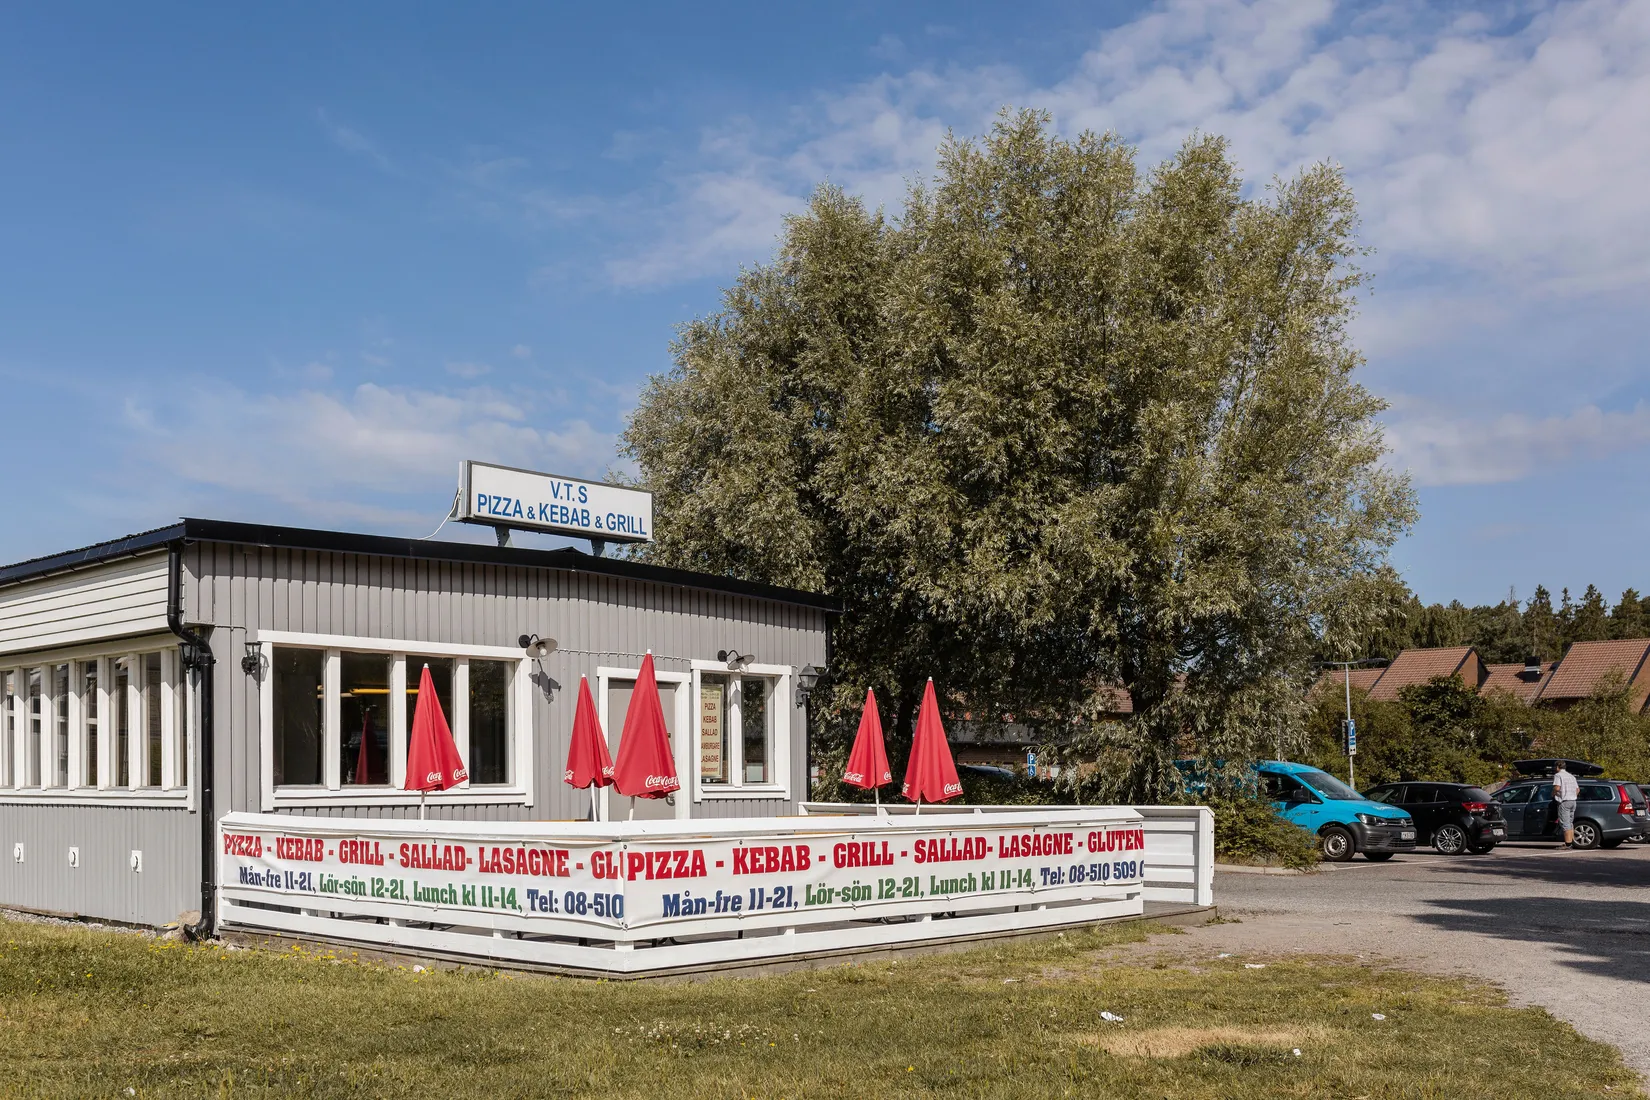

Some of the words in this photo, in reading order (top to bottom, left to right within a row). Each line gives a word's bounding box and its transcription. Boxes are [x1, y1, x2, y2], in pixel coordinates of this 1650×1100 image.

[550, 480, 588, 504] V.T.S
[477, 493, 523, 519] PIZZA
[527, 506, 536, 520] &
[539, 502, 591, 528] KEBAB
[594, 515, 603, 529] &
[606, 512, 647, 536] GRILL
[701, 754, 719, 763] ASAGNE
[223, 833, 263, 858] PIZZA
[275, 837, 325, 862] KEBAB
[338, 840, 384, 866] GRILL
[478, 846, 571, 877] LASAGNE
[627, 849, 707, 881] PIZZA
[732, 844, 811, 875] KEBAB
[833, 840, 894, 869] GRILL
[998, 832, 1074, 859] LASAGNE
[1087, 829, 1144, 853] GLUTEN
[239, 865, 282, 889] Mån-fre
[319, 872, 367, 896] Lör-sön
[413, 880, 458, 905] Lunch
[461, 883, 477, 907] kl
[526, 888, 559, 914] Tel:
[563, 890, 624, 919] 08-510
[662, 889, 742, 918] Mån-fre
[804, 880, 872, 906] Lör-sön
[929, 872, 977, 896] Lunch
[981, 870, 995, 891] kl
[1040, 865, 1065, 886] Tel:
[1068, 862, 1110, 884] 08-510
[1113, 860, 1137, 880] 509
